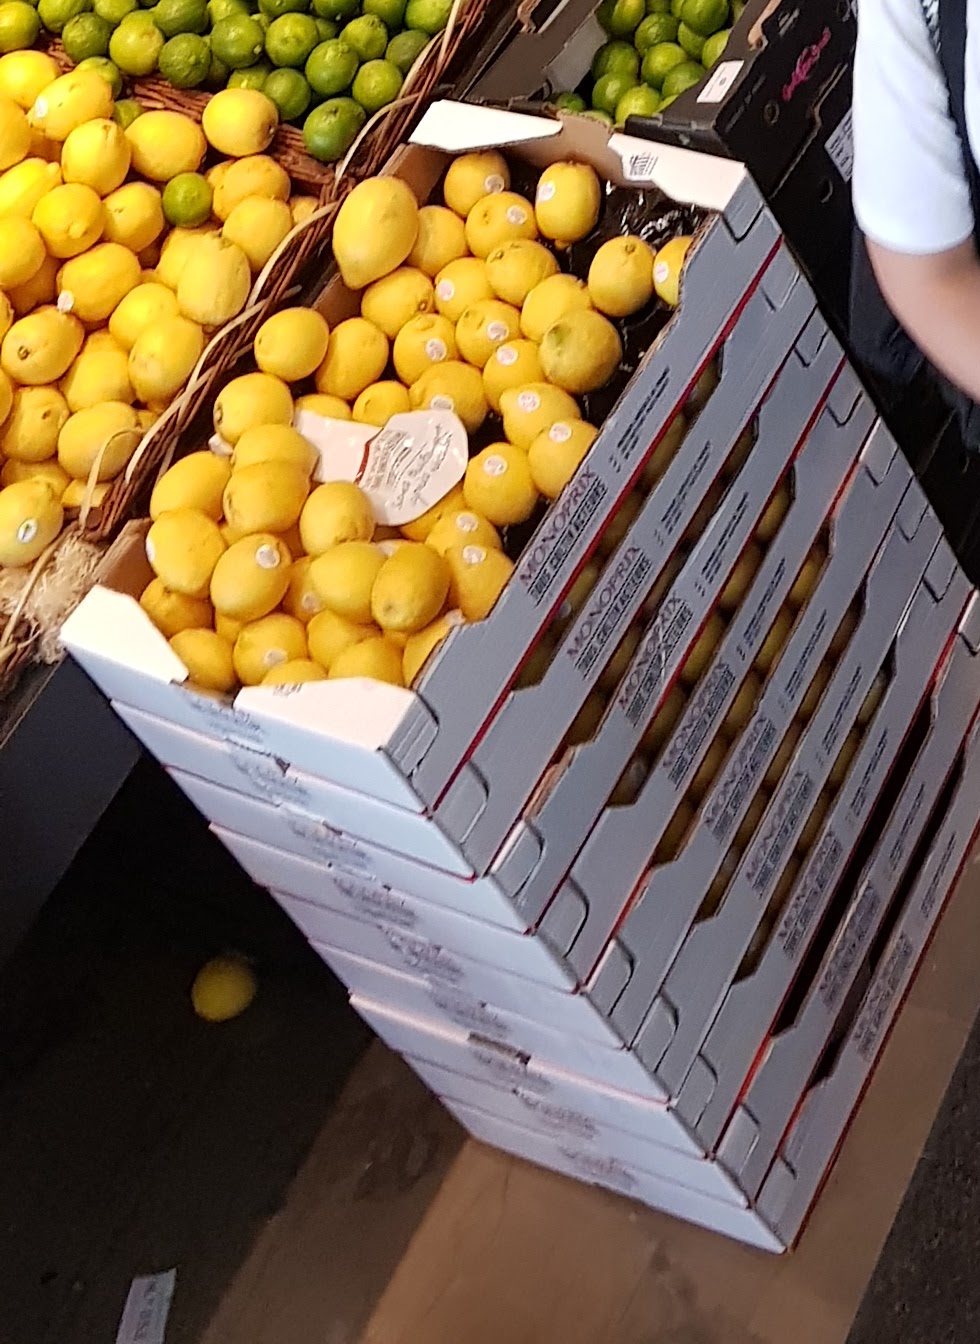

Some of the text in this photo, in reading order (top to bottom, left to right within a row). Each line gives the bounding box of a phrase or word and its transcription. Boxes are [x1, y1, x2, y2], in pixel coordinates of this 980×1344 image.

[518, 463, 597, 587] MONOPRIX
[565, 540, 641, 661] MONOPRIX
[616, 591, 681, 711] MONOPRIX
[662, 657, 727, 773] MONOPRIX
